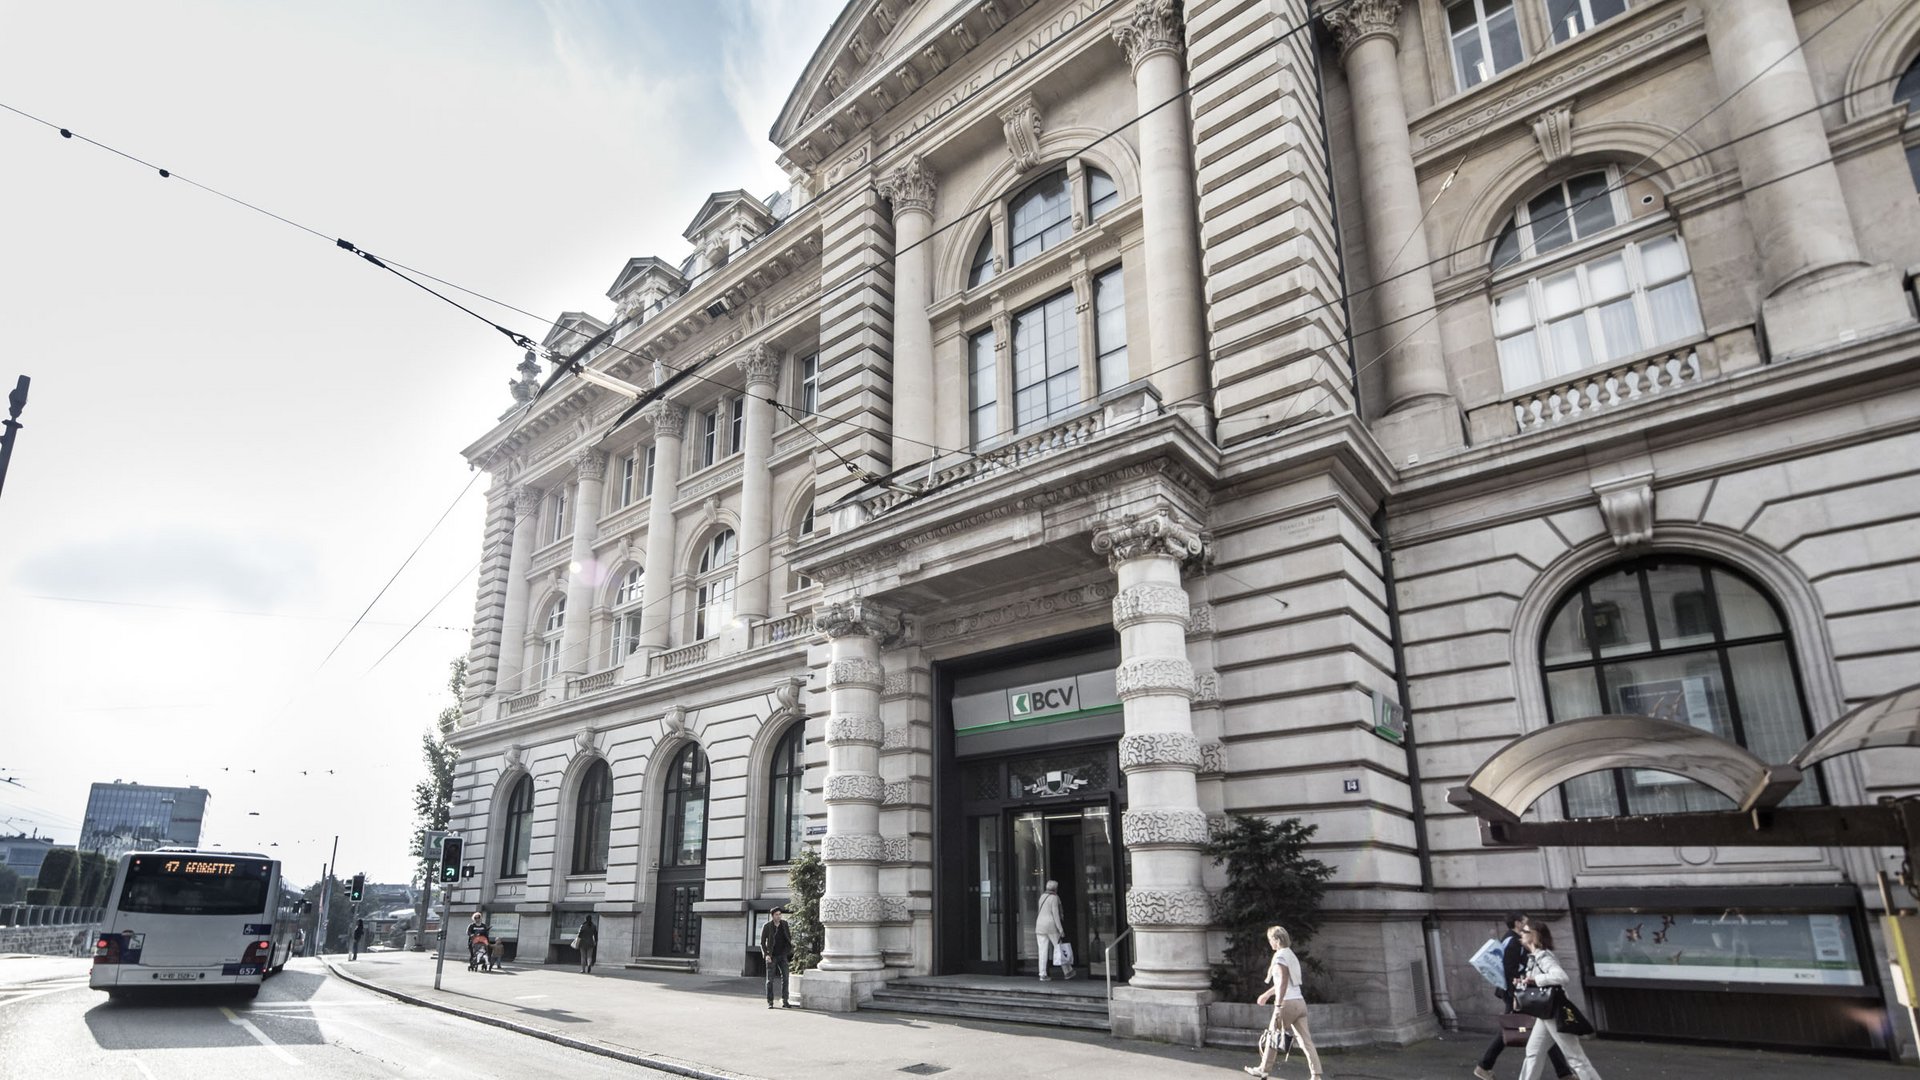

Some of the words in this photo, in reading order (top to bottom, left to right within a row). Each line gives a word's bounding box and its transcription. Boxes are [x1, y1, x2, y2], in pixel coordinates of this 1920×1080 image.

[1032, 685, 1074, 711] BCV
[1346, 781, 1358, 791] 14
[239, 967, 256, 975] 657
